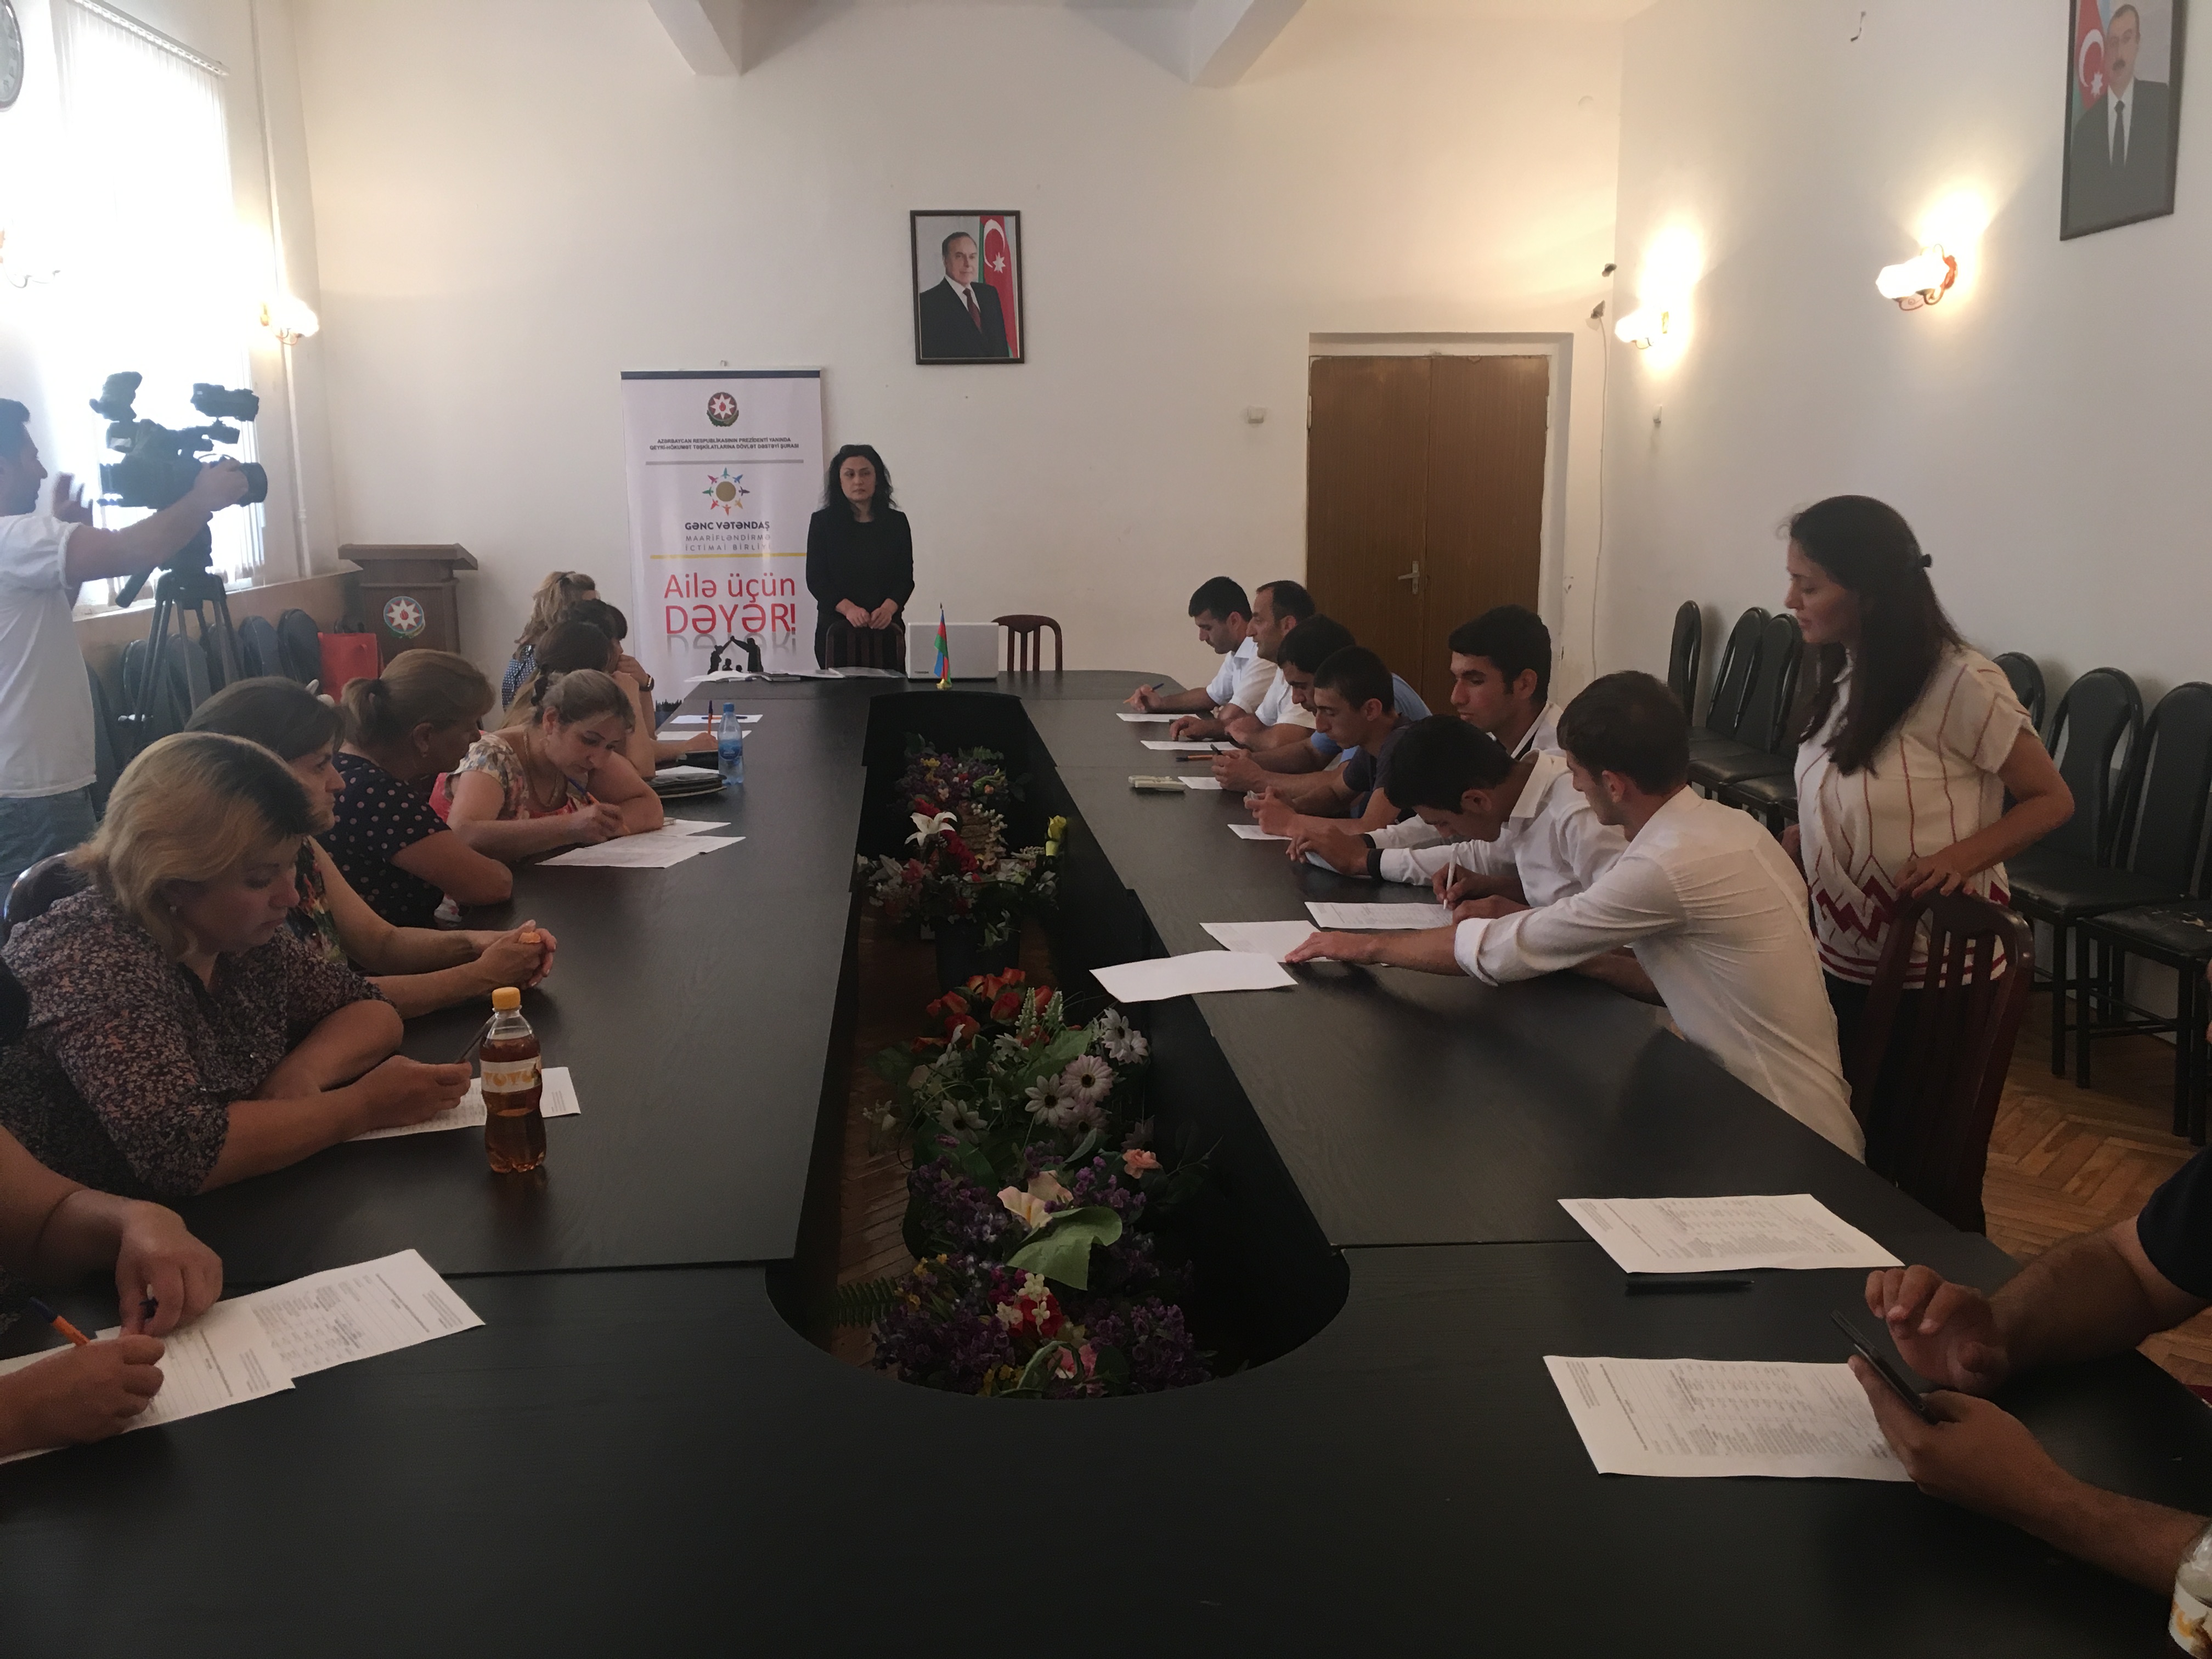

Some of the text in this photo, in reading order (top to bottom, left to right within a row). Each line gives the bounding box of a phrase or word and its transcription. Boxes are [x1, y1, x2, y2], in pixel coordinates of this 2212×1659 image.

[685, 521, 770, 531] GƏNC VƏTƏNDAŞ
[685, 533, 771, 541] MAARİFLƏNDİRMƏ
[664, 572, 795, 603] Ailə üçün
[665, 603, 796, 634] DƏYƏR!
